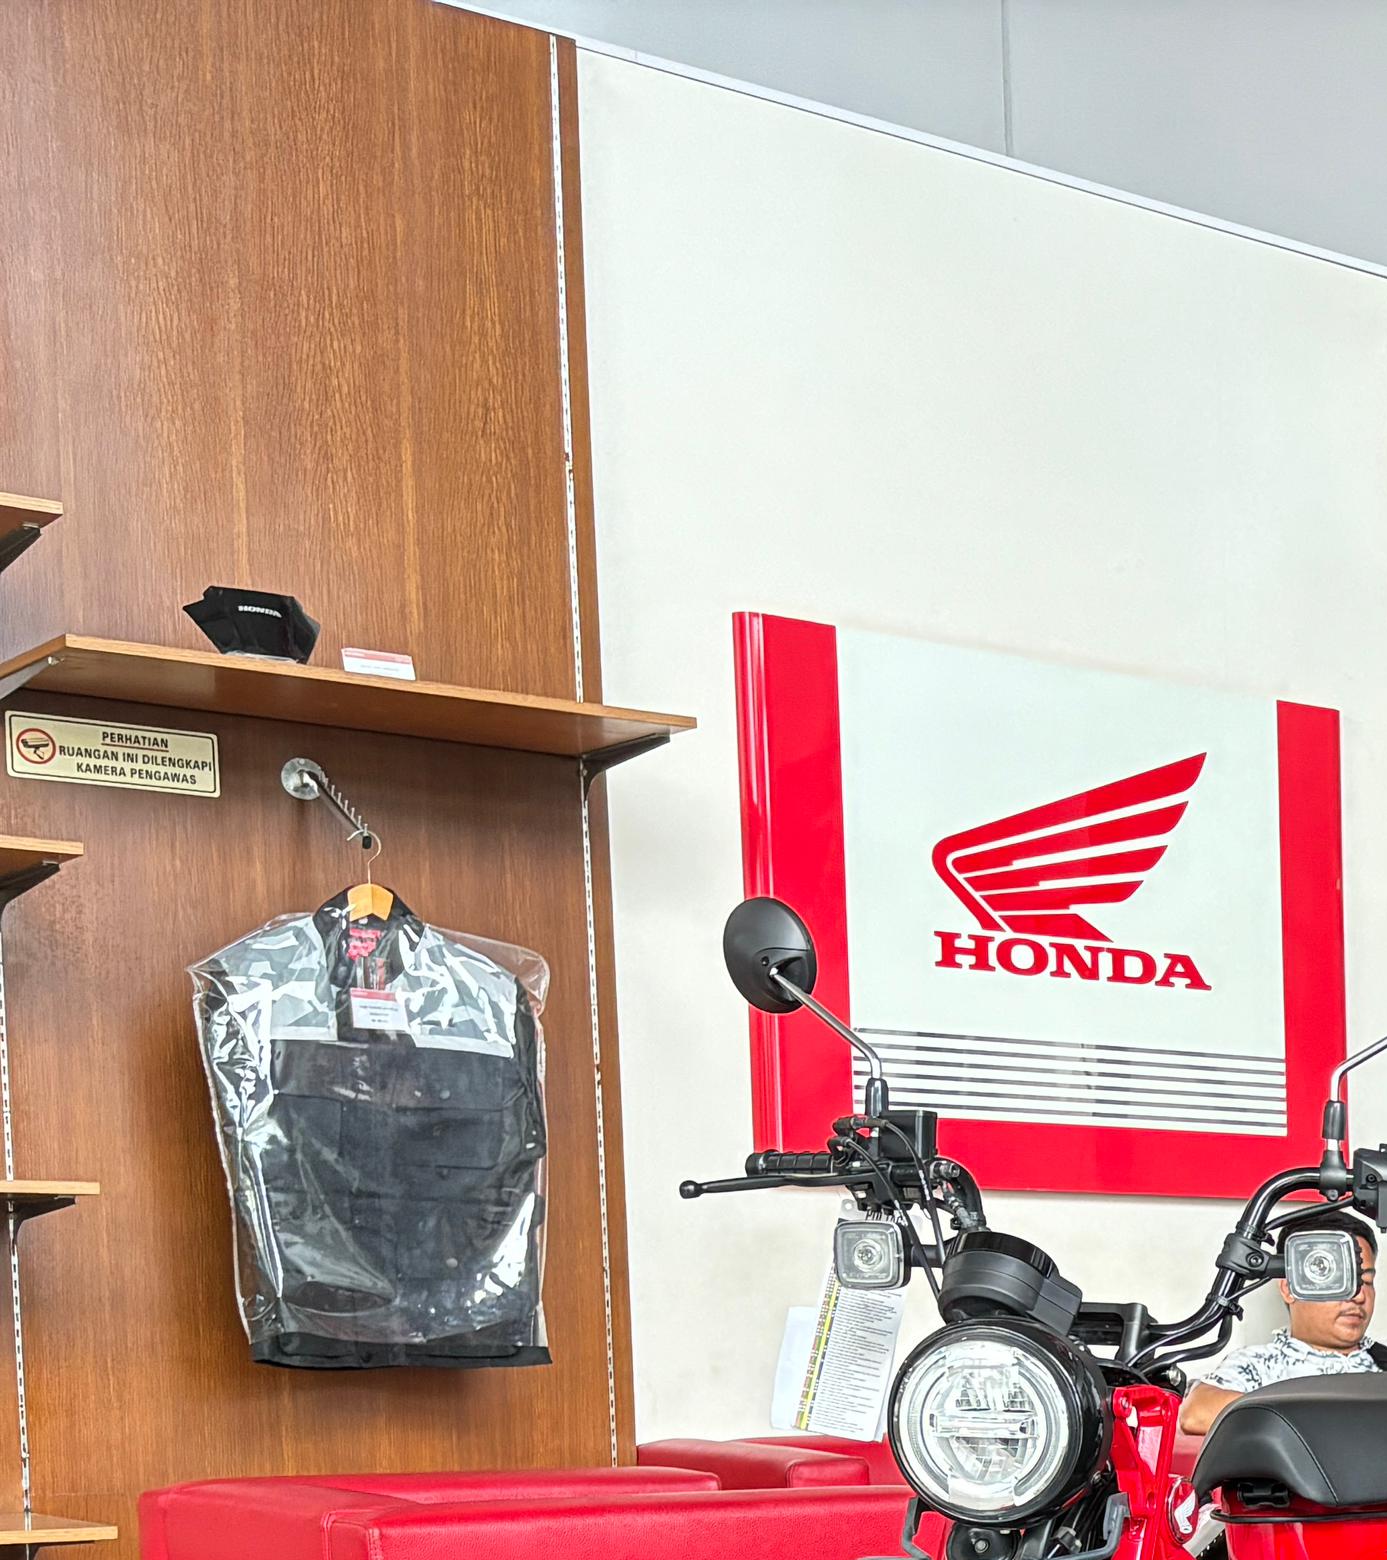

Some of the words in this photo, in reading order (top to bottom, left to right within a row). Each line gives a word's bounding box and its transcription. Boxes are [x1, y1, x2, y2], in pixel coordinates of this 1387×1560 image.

[238, 604, 283, 618] HONDA
[102, 731, 170, 749] PERHATIAN
[59, 745, 120, 762] RUANGAN
[122, 752, 139, 764] INI
[142, 754, 213, 772] DILENGKAPI
[76, 762, 126, 777] KAMERA
[130, 769, 197, 784] PENGAWAS
[934, 930, 1212, 991] HONDA
